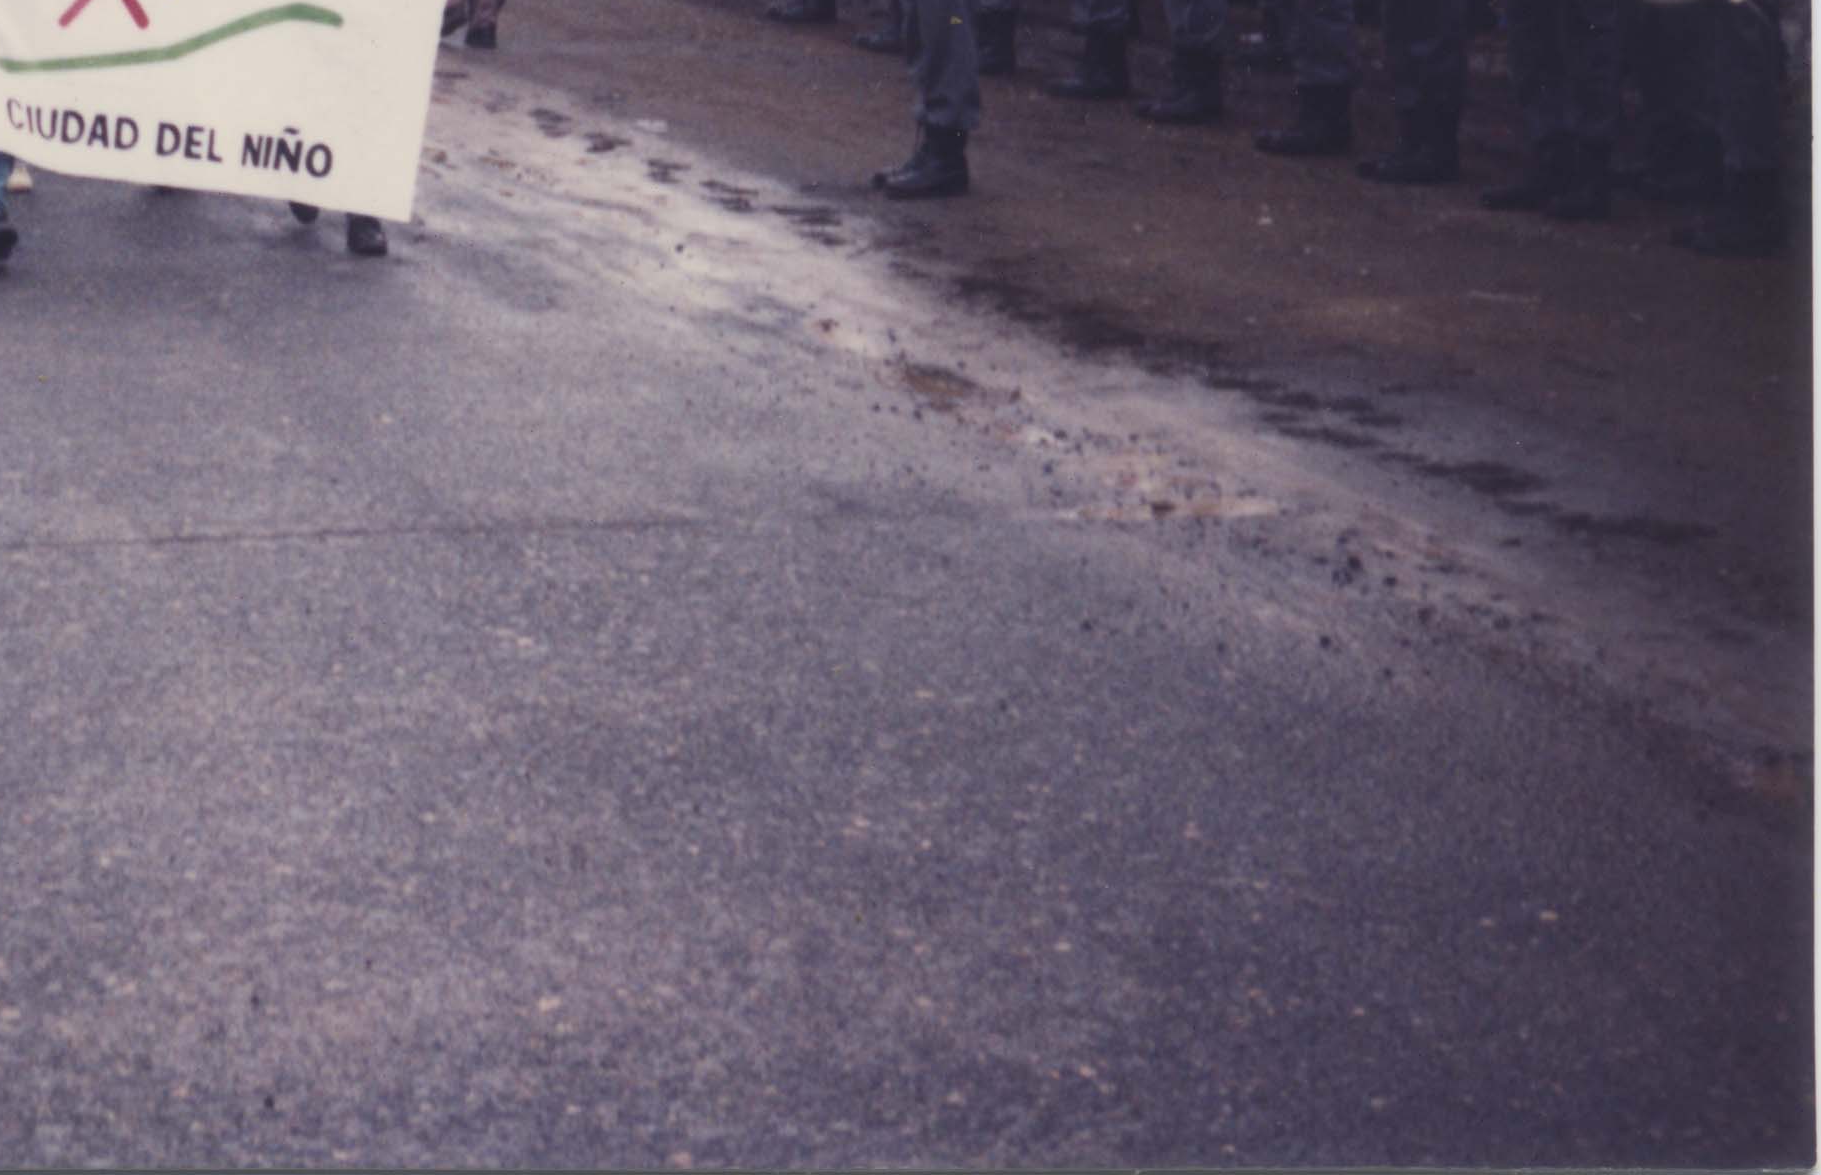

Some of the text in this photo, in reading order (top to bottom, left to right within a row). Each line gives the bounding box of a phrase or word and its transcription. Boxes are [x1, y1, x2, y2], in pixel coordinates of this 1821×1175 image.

[6, 98, 333, 178] CIUDAD DEL NIÑO
